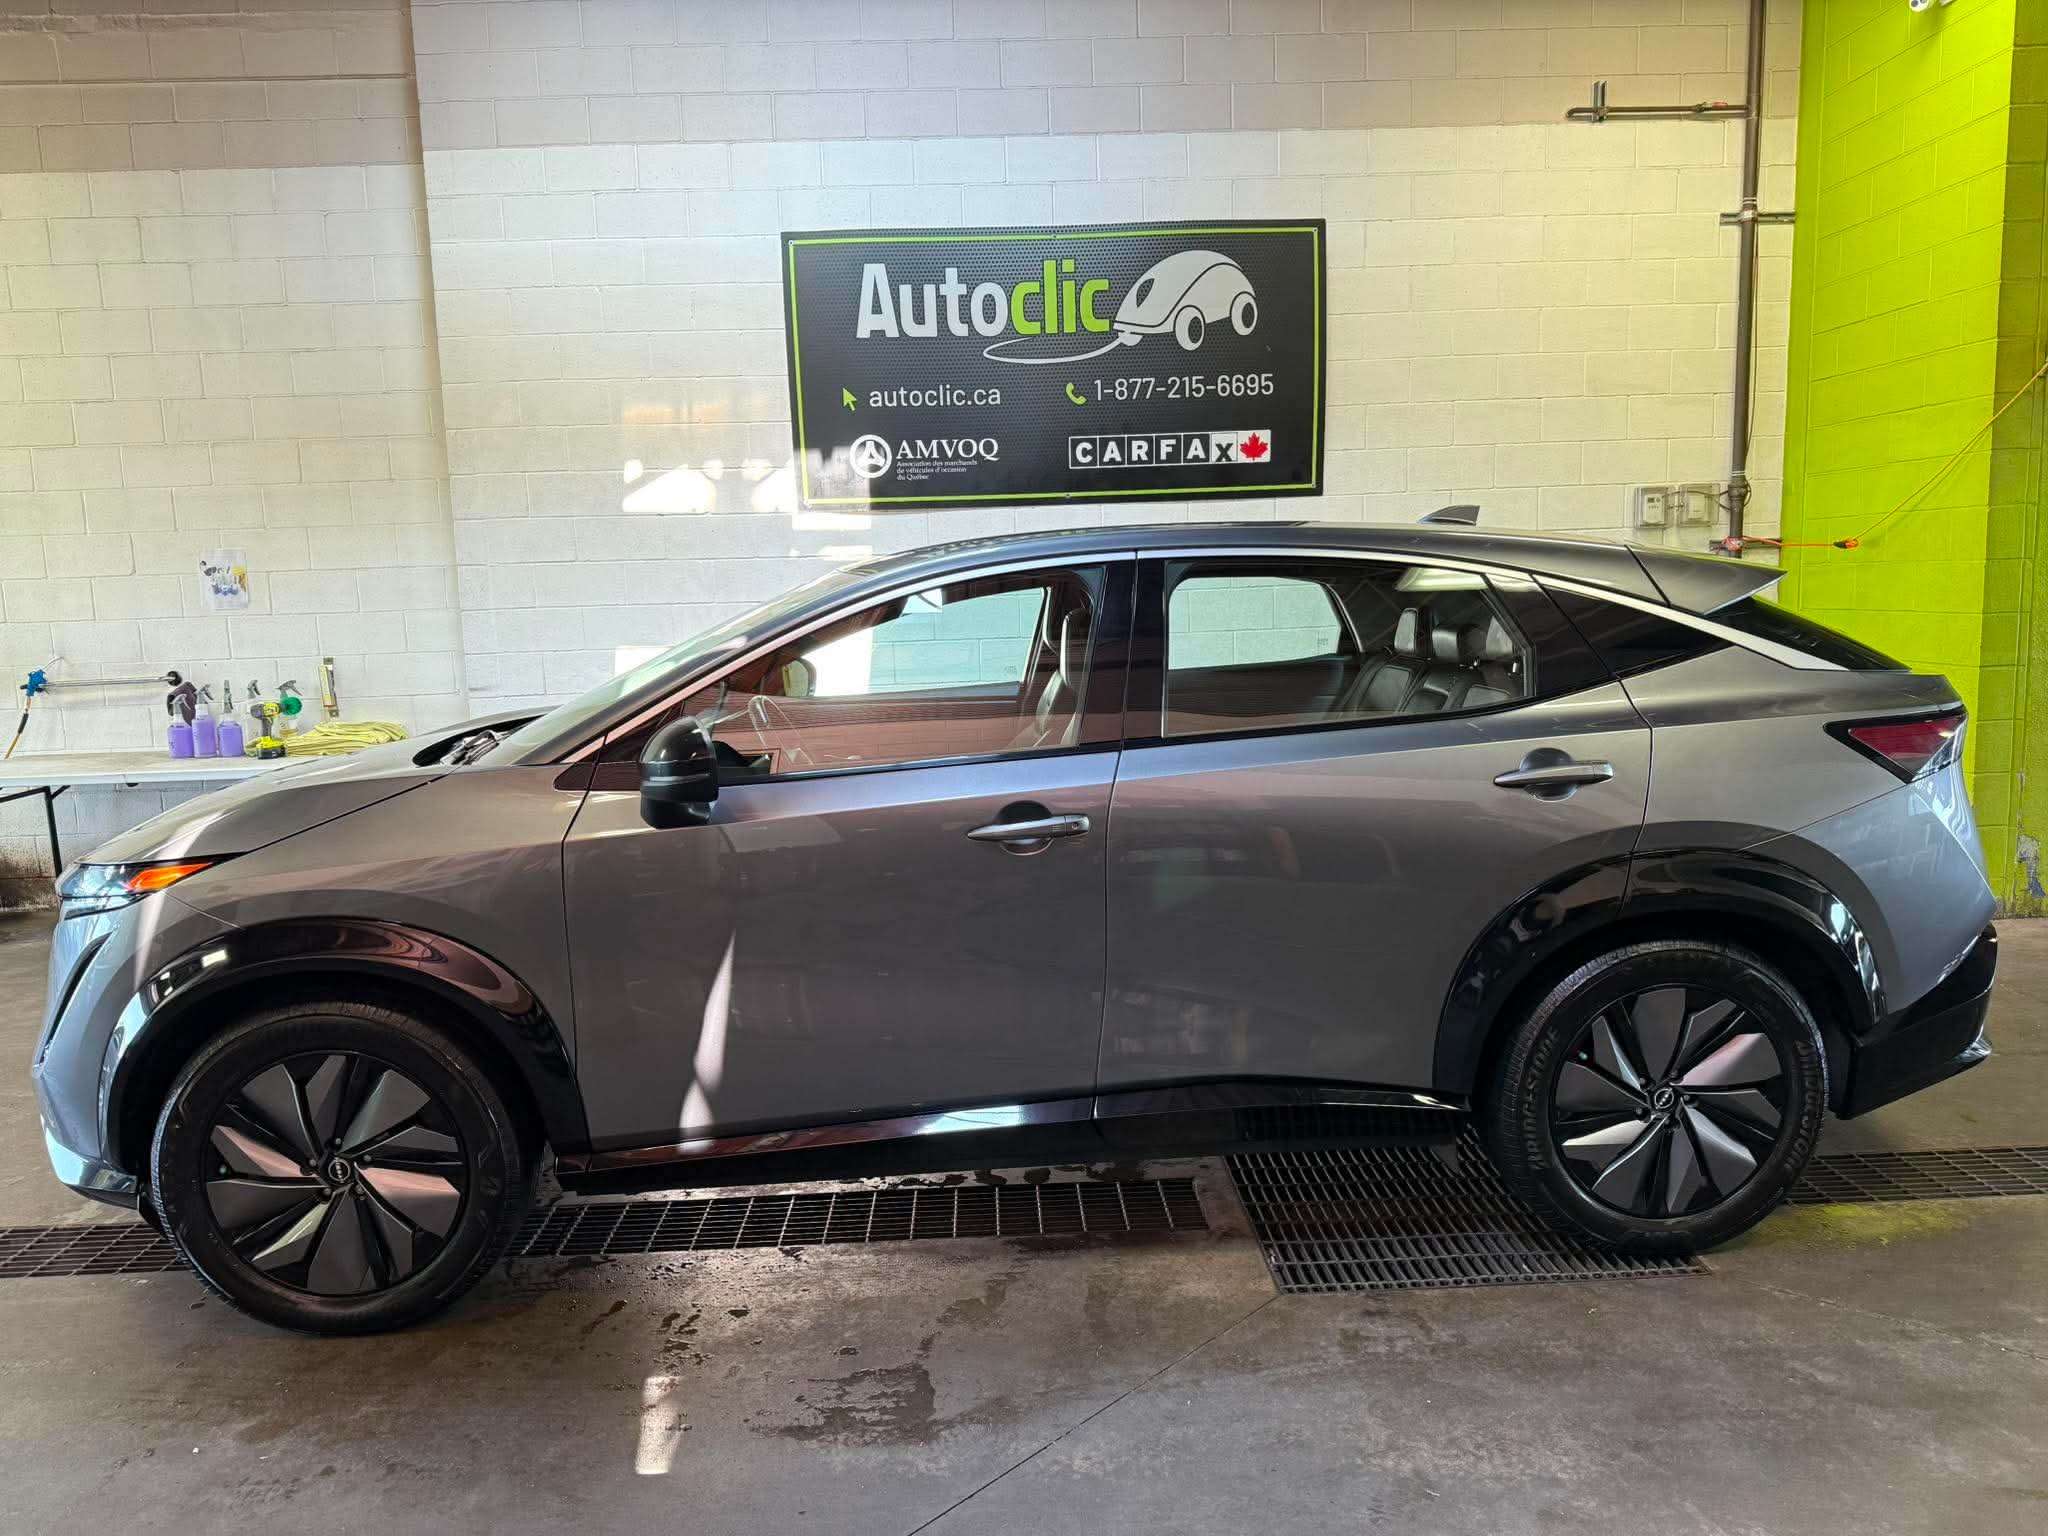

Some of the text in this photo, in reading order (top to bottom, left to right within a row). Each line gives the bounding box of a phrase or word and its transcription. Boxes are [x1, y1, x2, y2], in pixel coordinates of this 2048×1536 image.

[856, 258, 1111, 338] Autoclic
[868, 384, 1001, 408] autoclic.ca
[1093, 373, 1274, 402] 1-877-215-6695
[895, 438, 1000, 462] AMVOQ
[1075, 438, 1234, 463] CARFAX
